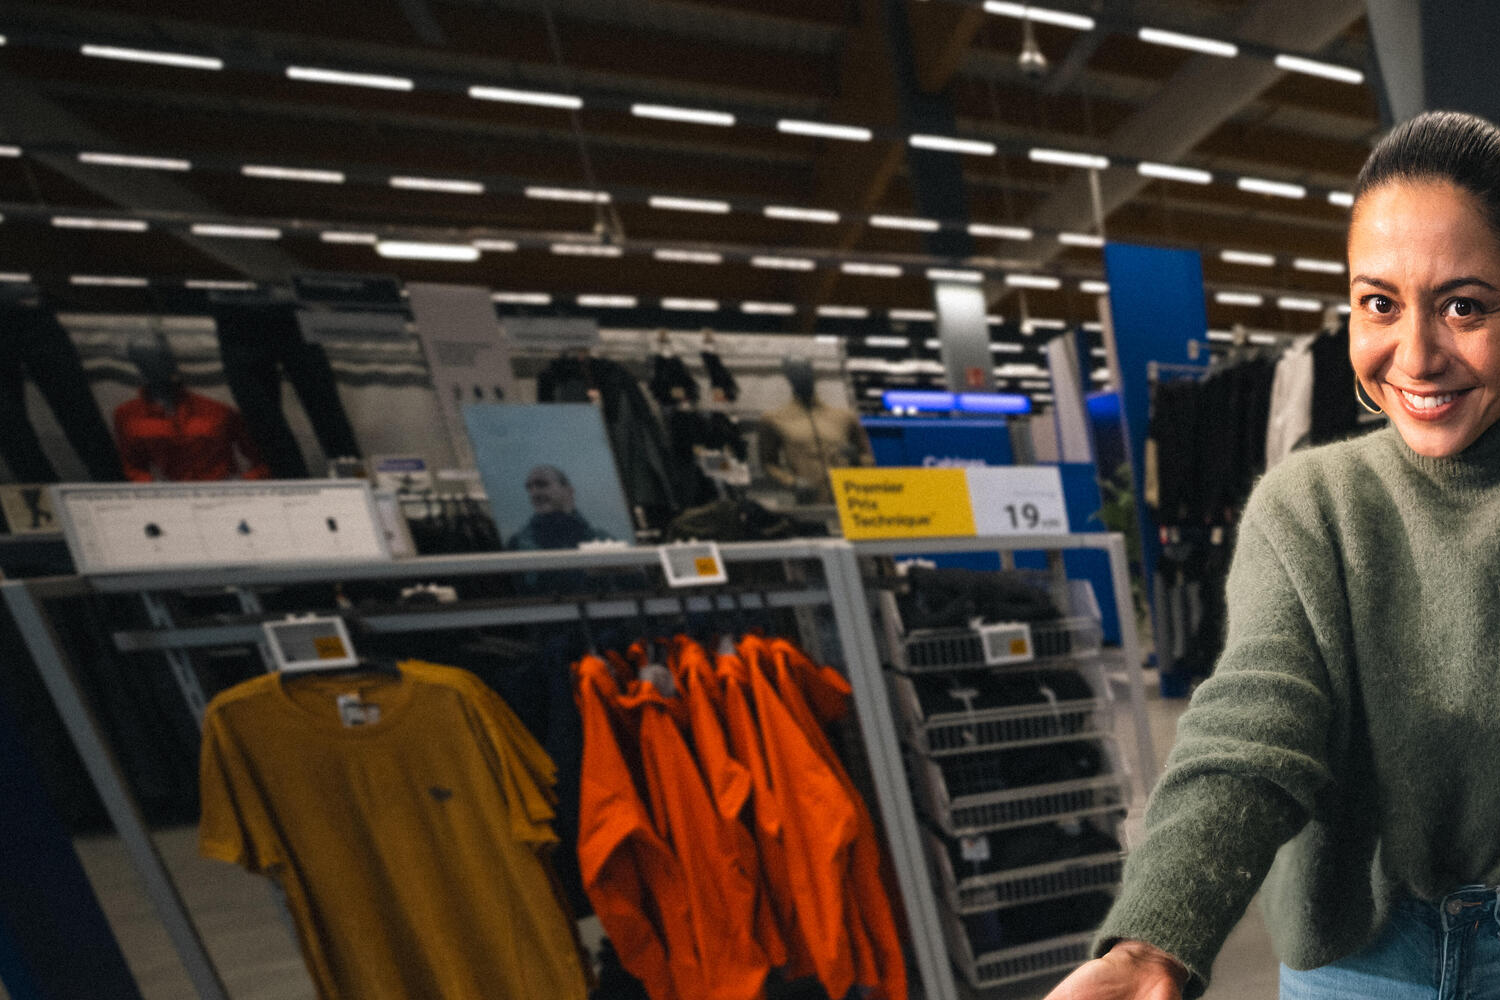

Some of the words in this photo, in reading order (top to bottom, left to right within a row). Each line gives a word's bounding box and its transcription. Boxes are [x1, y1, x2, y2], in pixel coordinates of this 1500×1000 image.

[843, 480, 904, 494] Premier
[847, 496, 878, 511] Prix
[1003, 502, 1040, 529] 19
